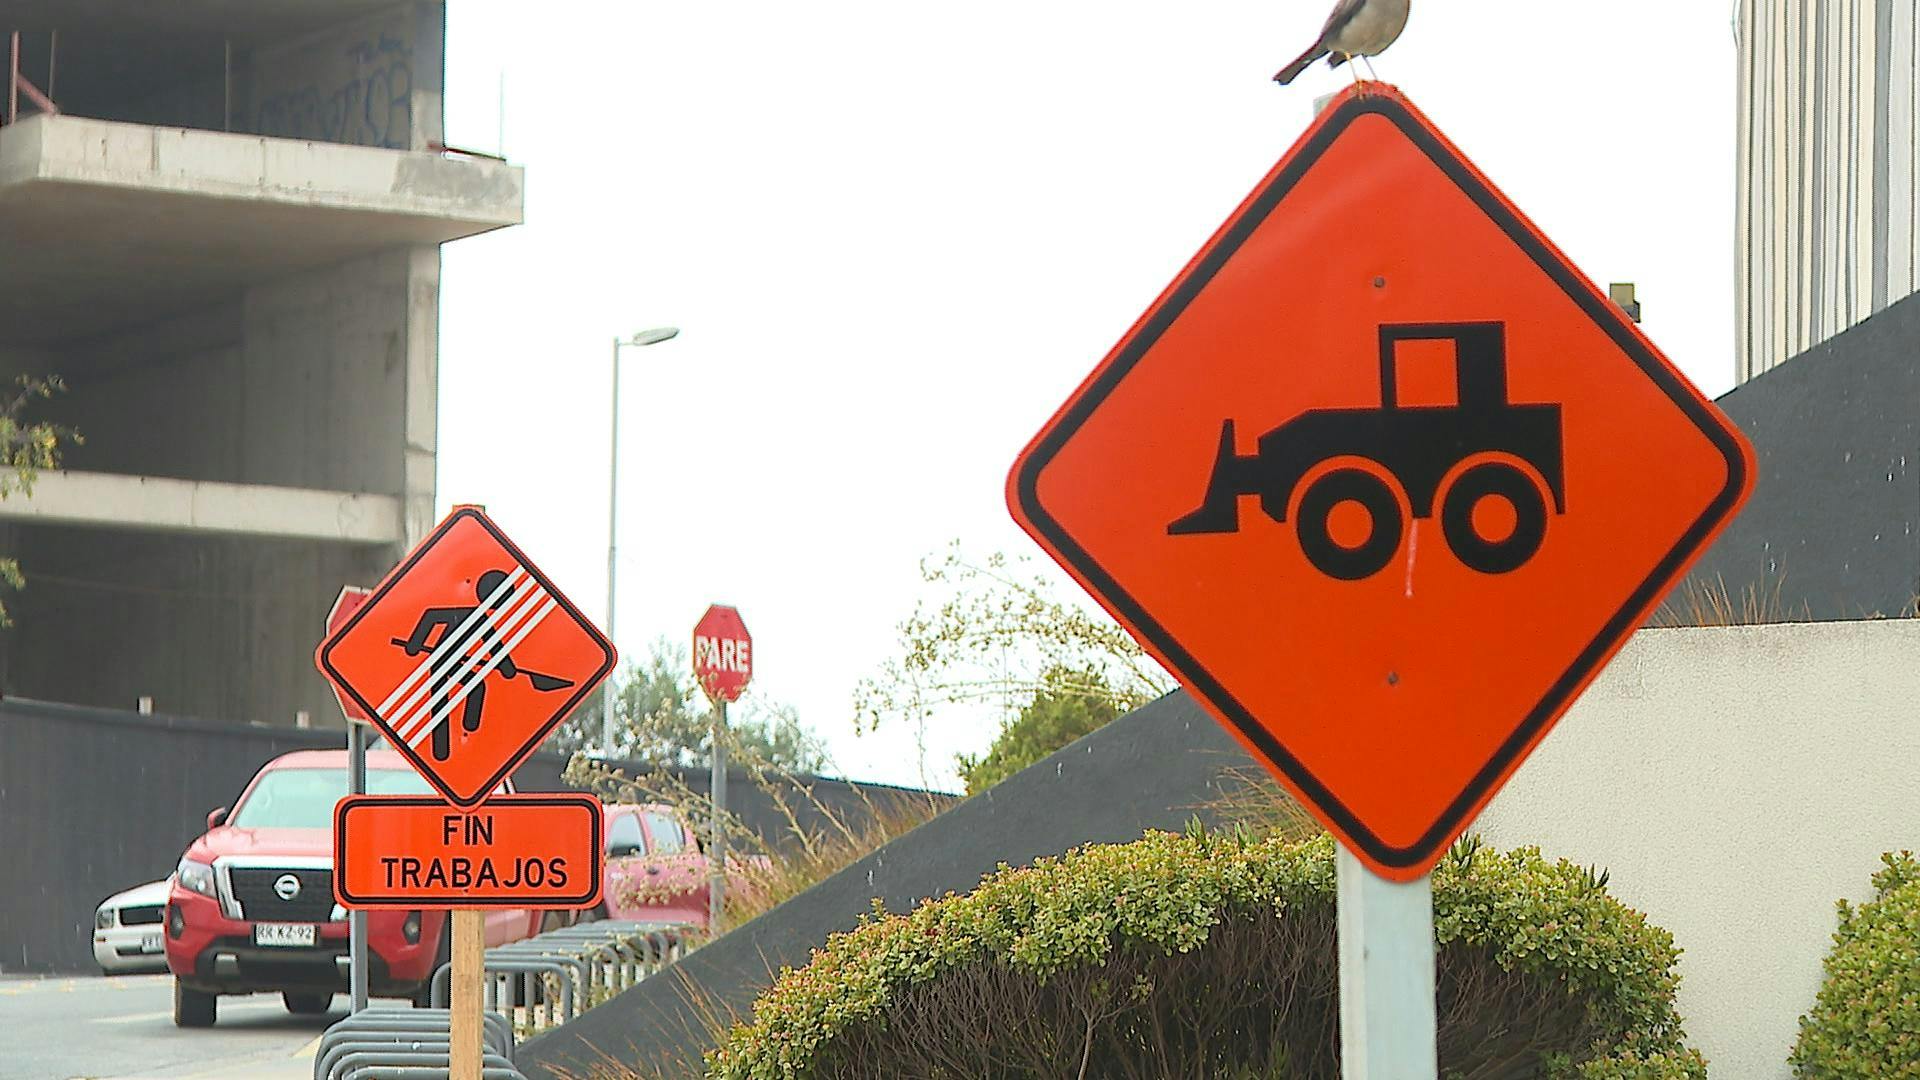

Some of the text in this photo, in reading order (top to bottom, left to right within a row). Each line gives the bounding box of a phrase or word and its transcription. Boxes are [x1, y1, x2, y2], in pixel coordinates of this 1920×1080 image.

[695, 635, 749, 673] PARE
[443, 815, 493, 846] FIN
[381, 857, 568, 888] TRABAJOS
